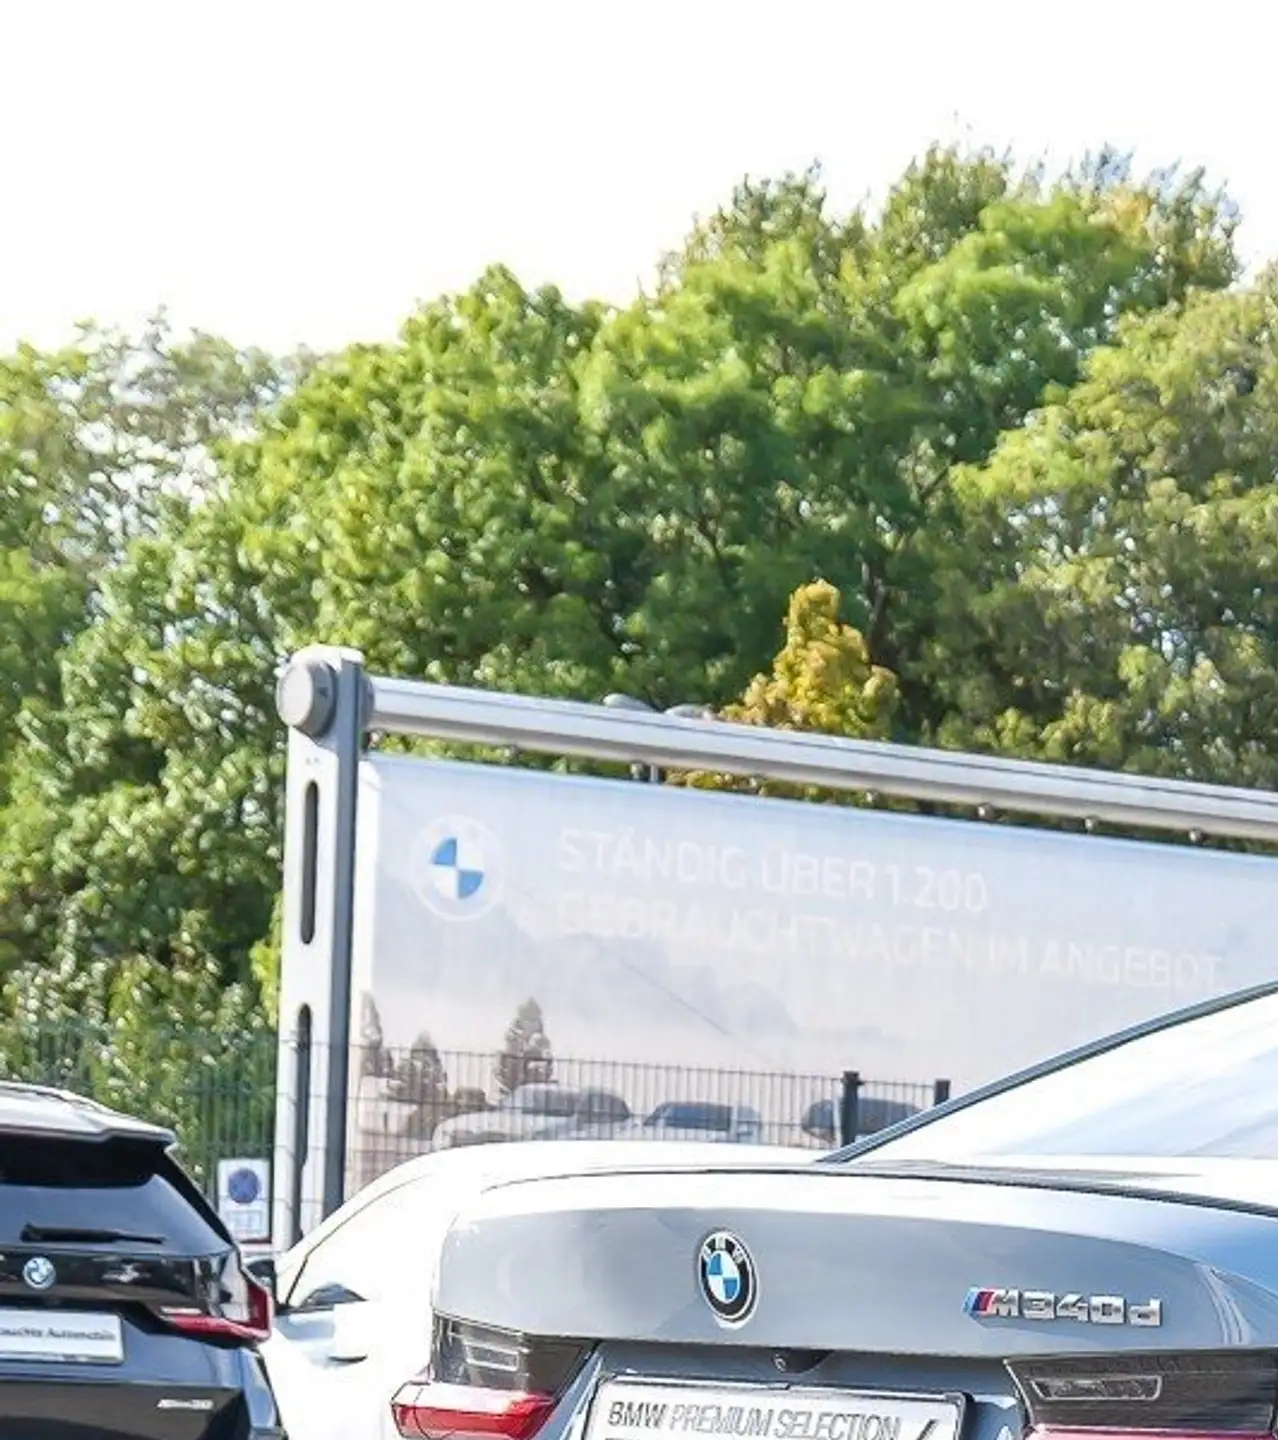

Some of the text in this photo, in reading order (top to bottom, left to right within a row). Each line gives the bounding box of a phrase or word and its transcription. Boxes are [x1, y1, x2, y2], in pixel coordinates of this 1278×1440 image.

[558, 822, 747, 891] STÄNDIG
[1040, 939, 1223, 993] ANGEBOT
[963, 1286, 1162, 1327] M340d
[607, 1400, 667, 1429] BMW
[669, 1402, 774, 1437] PREMIUM
